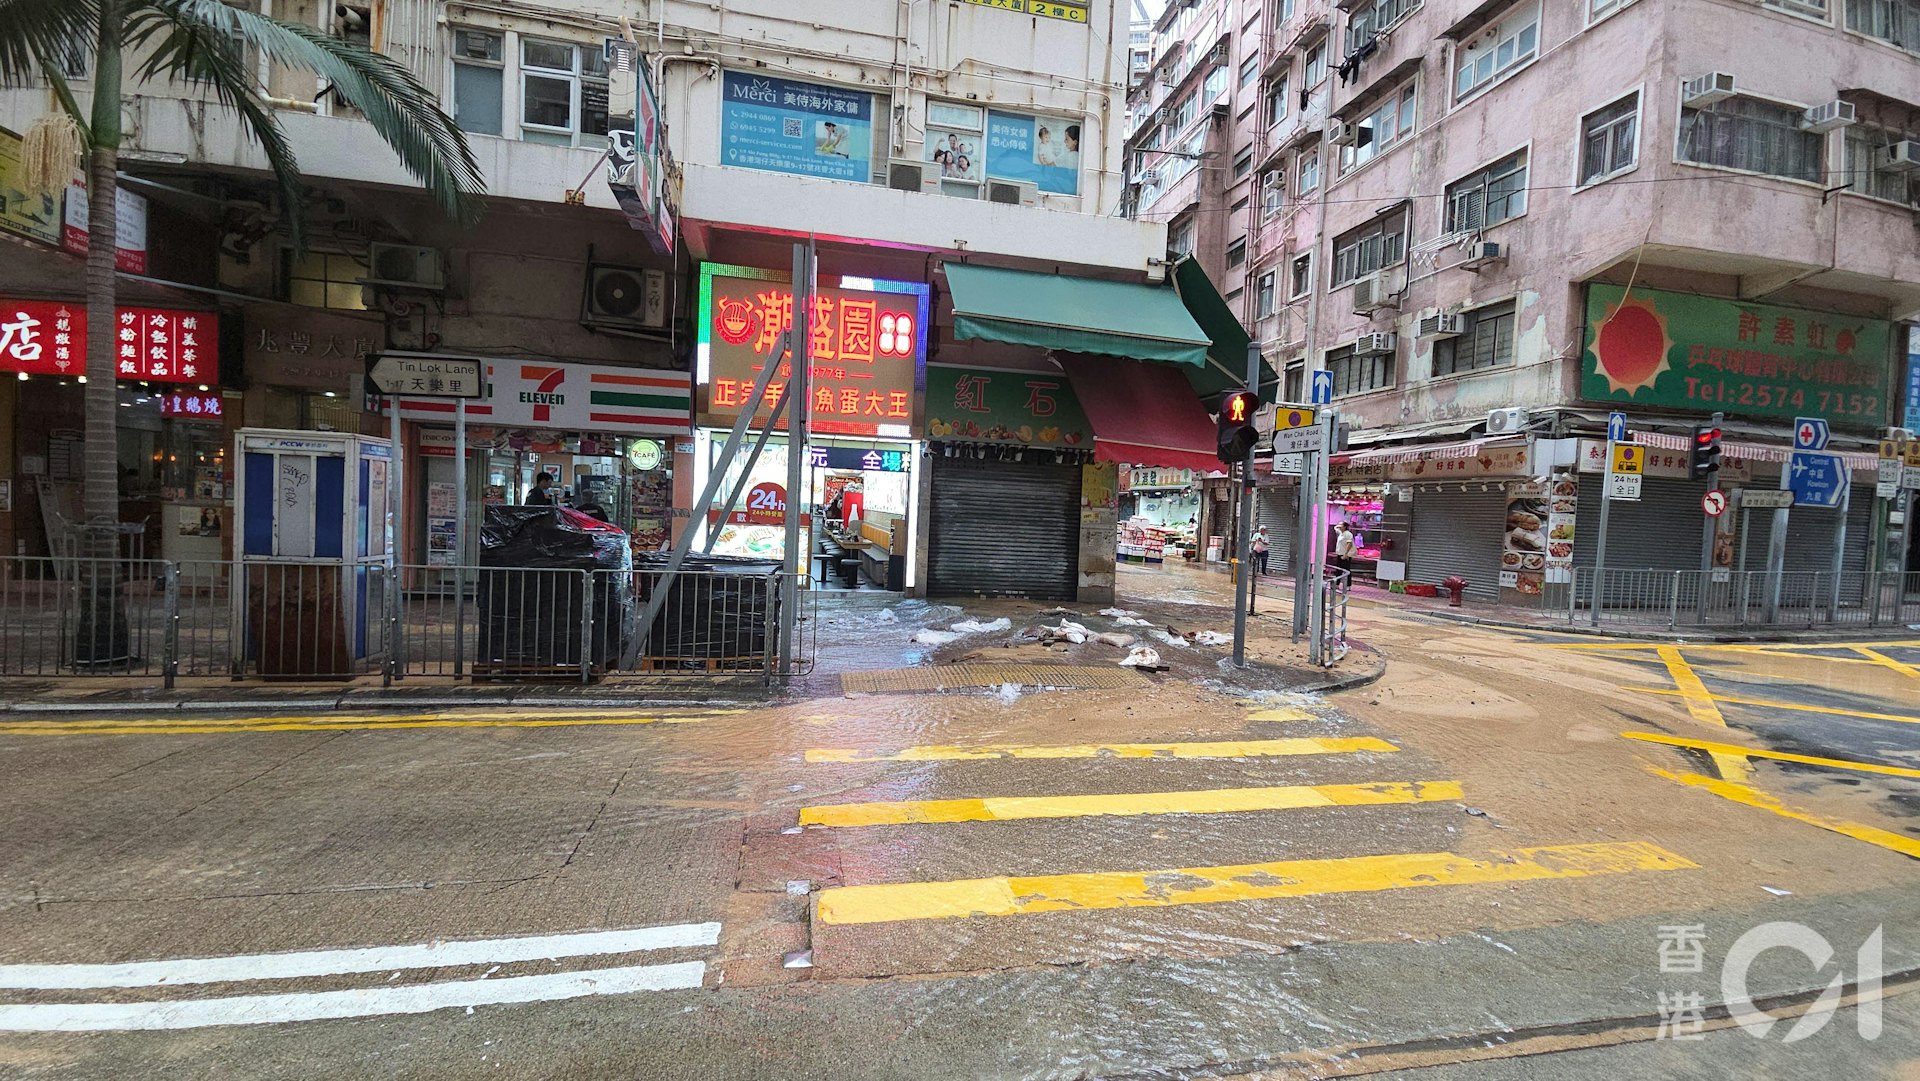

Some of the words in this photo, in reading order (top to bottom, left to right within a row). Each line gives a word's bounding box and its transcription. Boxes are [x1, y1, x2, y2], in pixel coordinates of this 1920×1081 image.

[733, 83, 776, 104] Merci
[783, 92, 859, 115] 美侍海外家傭
[740, 137, 803, 151] merci-services.com
[0, 312, 42, 361] 店
[397, 361, 416, 372] Tin
[419, 362, 441, 373] Lok
[445, 364, 475, 375] Lane
[411, 378, 463, 393] 天樂里
[520, 365, 565, 421] 7
[714, 378, 910, 418] 正宗手魚蛋大王
[1818, 391, 1878, 416] 7152
[280, 440, 304, 448] PCCW
[1614, 475, 1625, 483] 24
[1626, 475, 1639, 484] hrs
[1616, 485, 1635, 495] 全日
